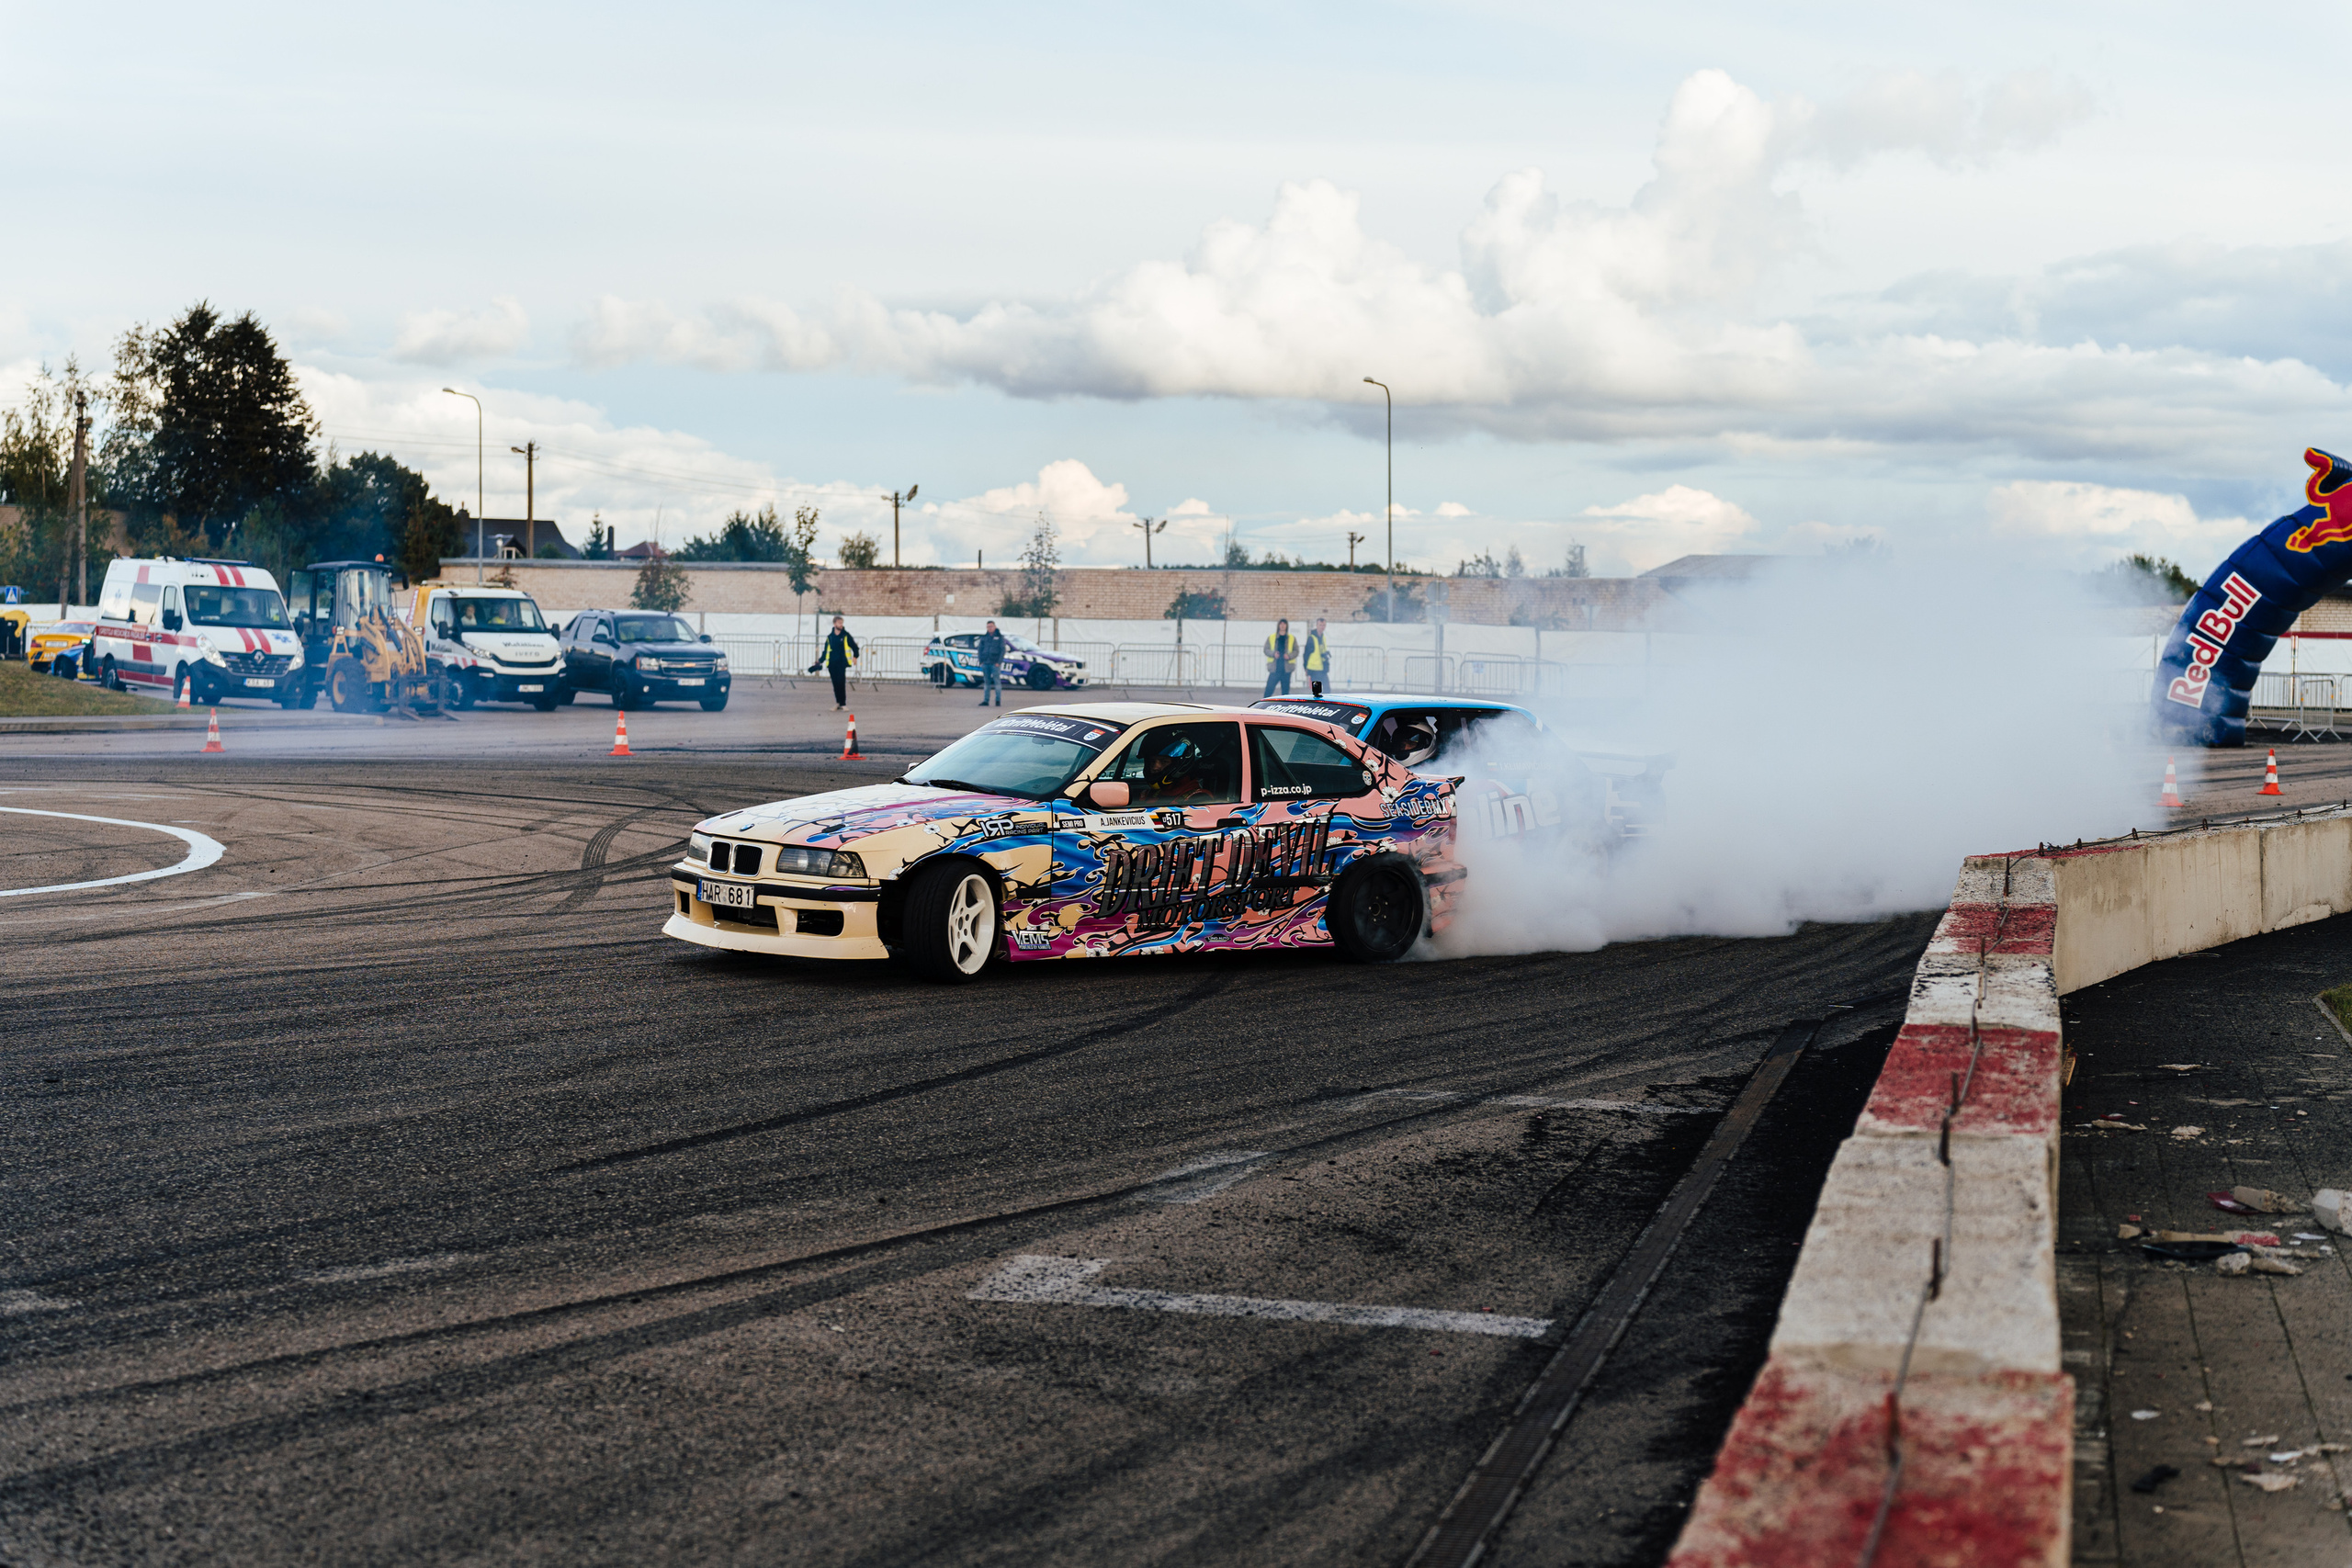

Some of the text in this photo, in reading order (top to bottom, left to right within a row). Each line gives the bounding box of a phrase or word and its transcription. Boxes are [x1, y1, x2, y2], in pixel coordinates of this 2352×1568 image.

[2169, 573, 2260, 707] Red Bull
[1261, 783, 1312, 797] p-izza.co.jp
[1379, 799, 1449, 818] SEASIDEBMX
[1074, 819, 1084, 828] PRO
[1166, 813, 1181, 826] 517
[1094, 815, 1337, 919] DRIFT DEVIL
[702, 882, 751, 907] HAR 681
[1135, 886, 1297, 933] MOTORSPORT
[1011, 930, 1050, 945] VEMS
